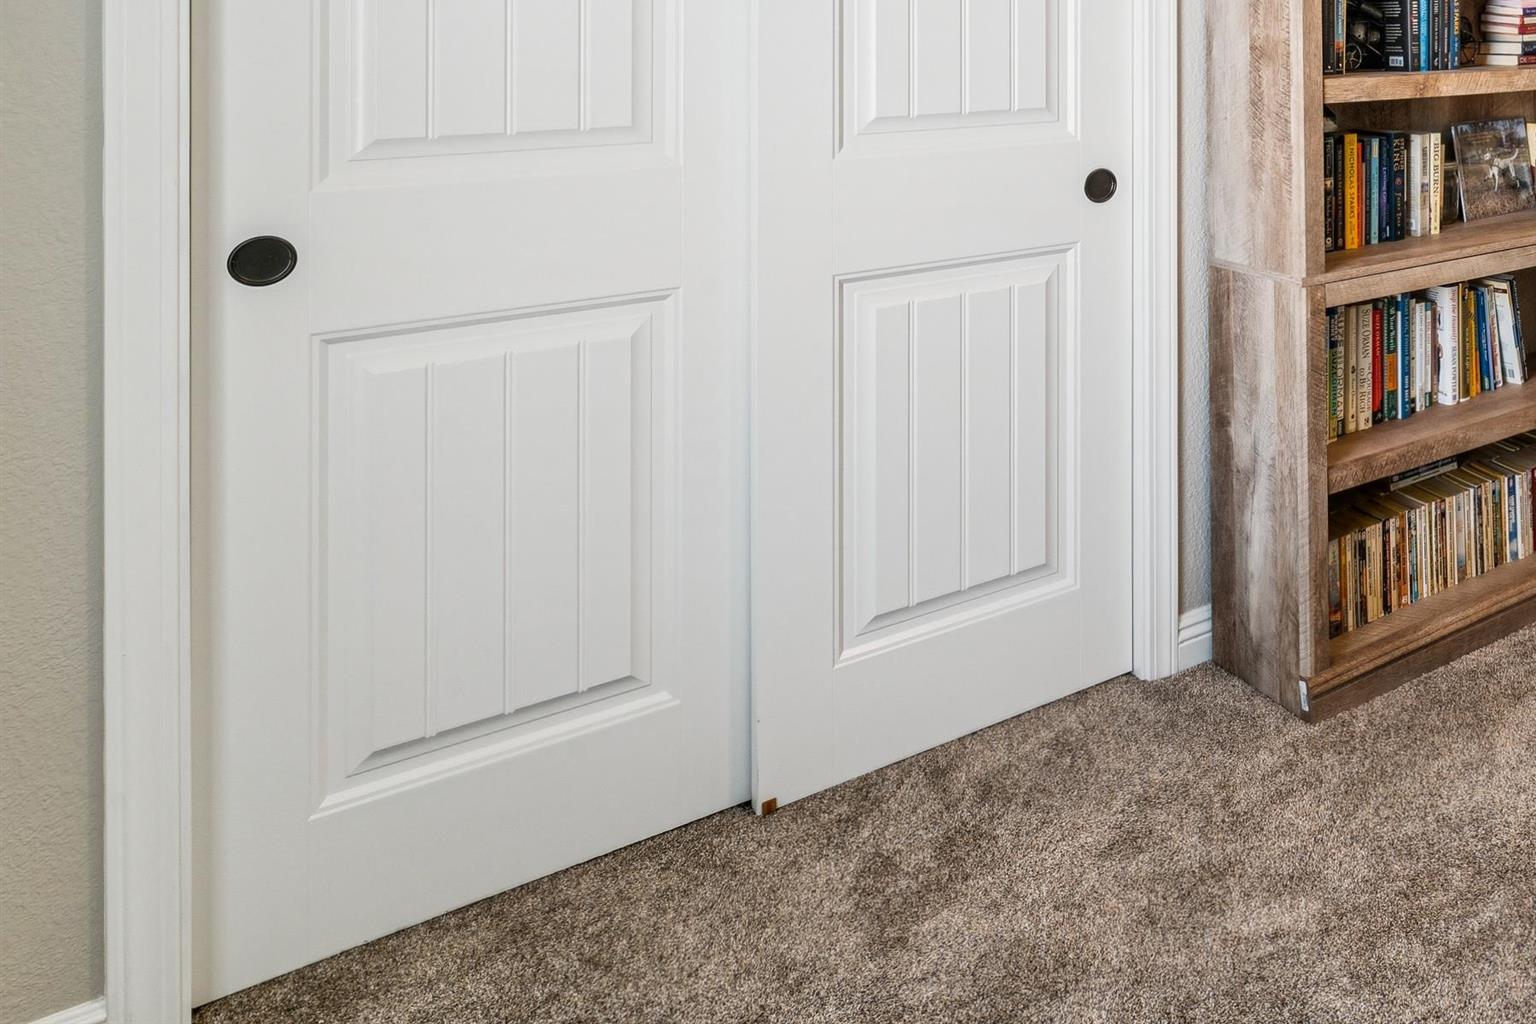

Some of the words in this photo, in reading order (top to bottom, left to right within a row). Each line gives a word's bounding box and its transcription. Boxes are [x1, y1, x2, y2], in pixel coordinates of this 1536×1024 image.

[1393, 138, 1401, 171] KING
[1361, 309, 1371, 329] SUZE
[1362, 330, 1371, 359] ORMAN
